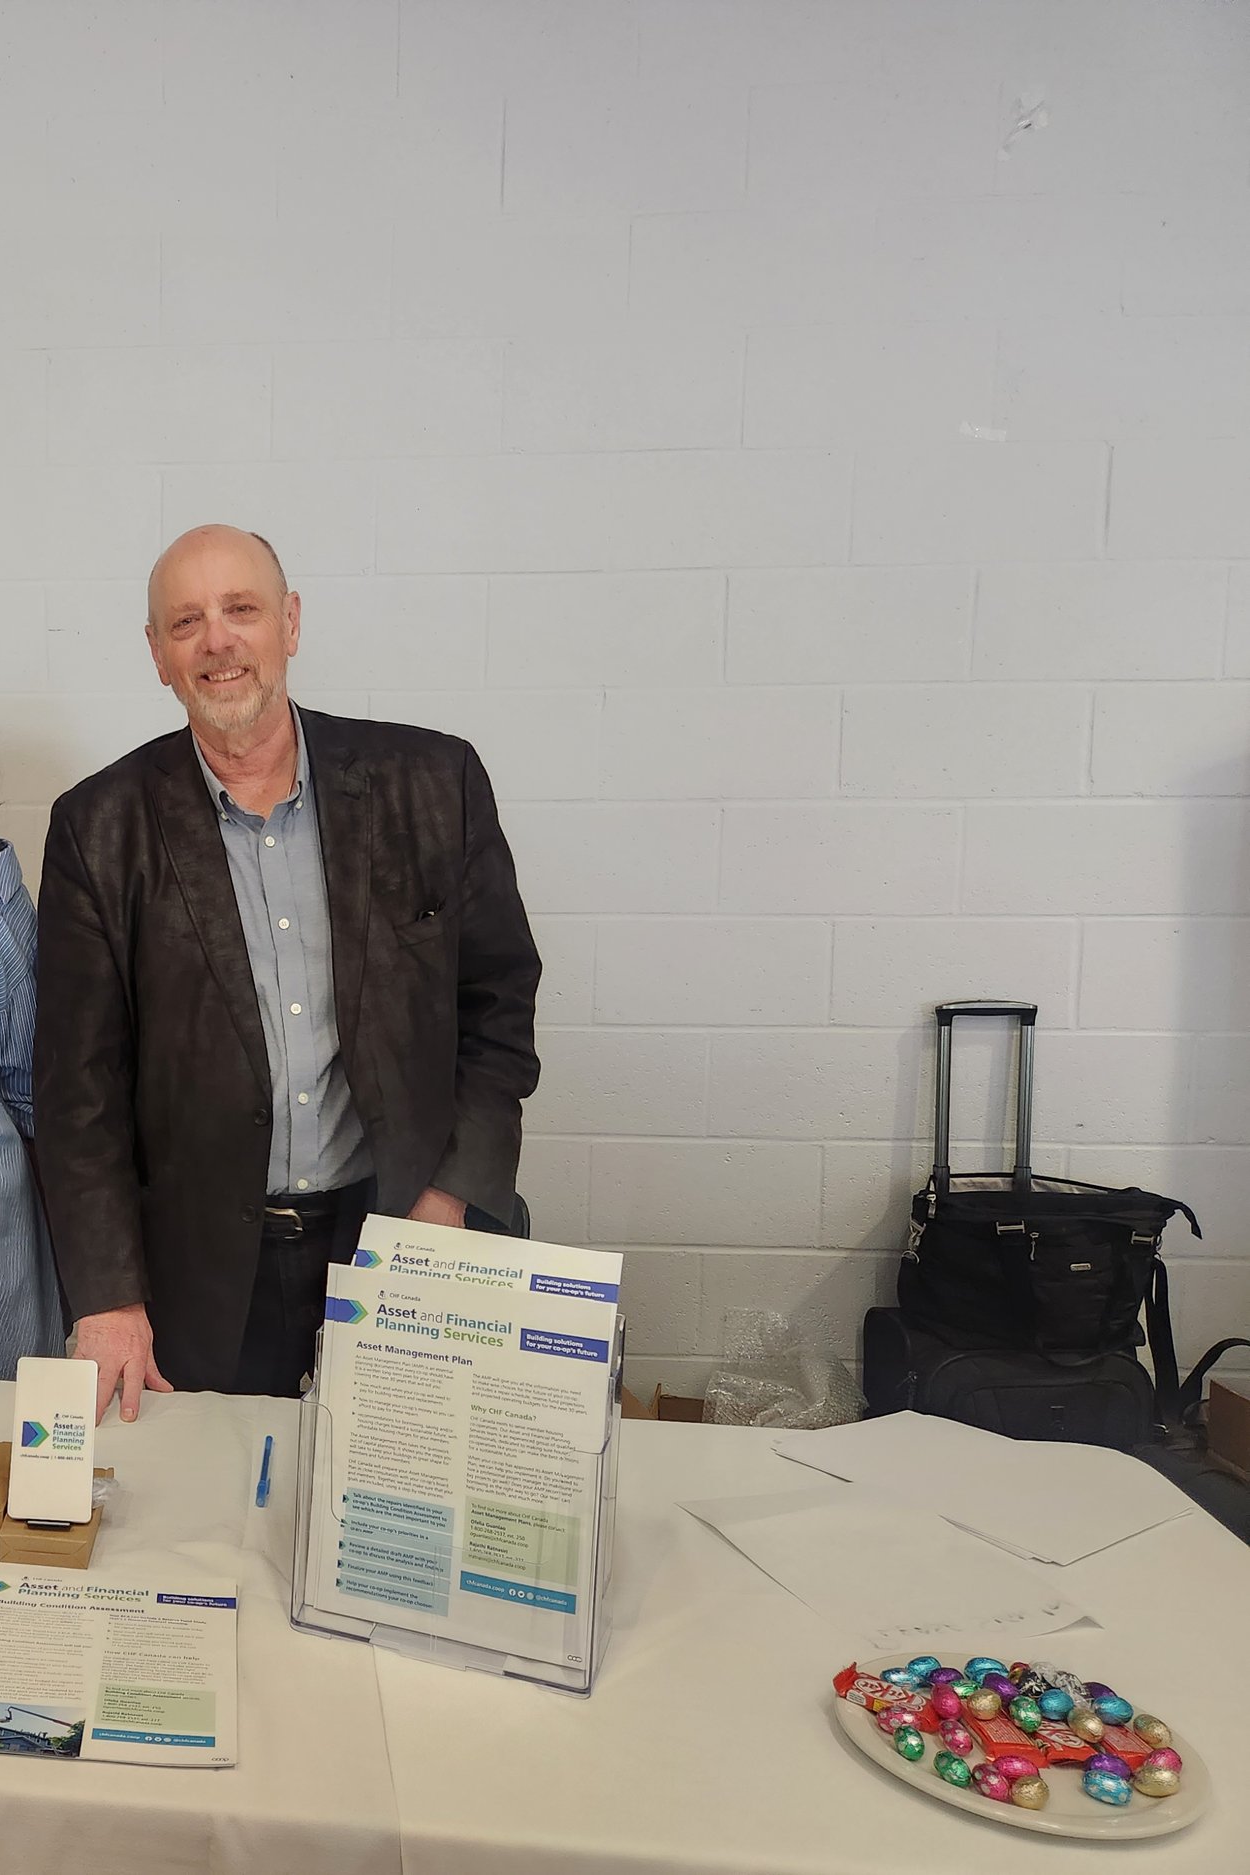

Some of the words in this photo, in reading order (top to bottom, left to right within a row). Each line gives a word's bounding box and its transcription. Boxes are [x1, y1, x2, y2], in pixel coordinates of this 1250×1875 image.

[392, 1254, 430, 1267] Asset
[433, 1260, 455, 1271] and
[458, 1262, 523, 1279] Financial
[537, 1279, 562, 1287] Building
[377, 1304, 417, 1320] Asset
[420, 1312, 443, 1323] and
[447, 1314, 512, 1334] Financial
[376, 1318, 440, 1339] Planning
[444, 1328, 504, 1347] Services
[527, 1334, 553, 1344] Building
[554, 1339, 583, 1348] solutions
[357, 1341, 383, 1352] Asset
[385, 1345, 449, 1362] Management
[452, 1356, 473, 1366] Plan
[553, 1345, 576, 1354] co-op's
[577, 1349, 598, 1357] future
[471, 1405, 487, 1414] Why
[505, 1411, 537, 1421] Canada?
[53, 1436, 84, 1445] Planning
[52, 1443, 81, 1451] Services
[390, 1507, 412, 1515] Condition
[485, 1512, 517, 1523] Management
[18, 1589, 80, 1599] Planning
[84, 1593, 141, 1602] Services
[62, 1584, 84, 1592] and
[87, 1586, 149, 1596] Financial
